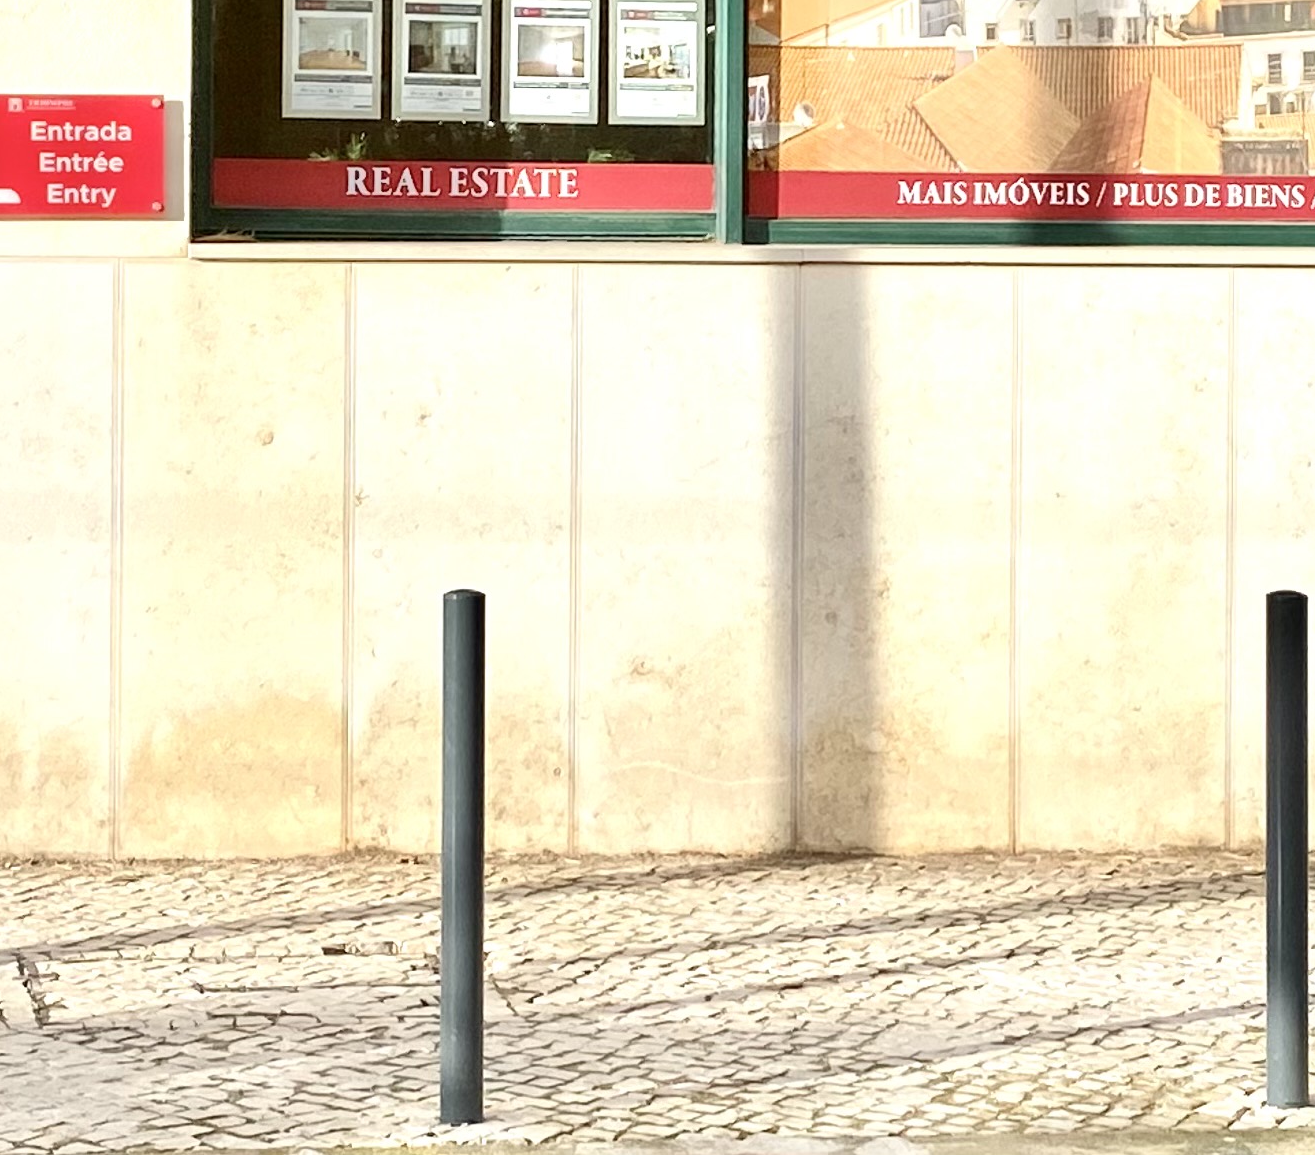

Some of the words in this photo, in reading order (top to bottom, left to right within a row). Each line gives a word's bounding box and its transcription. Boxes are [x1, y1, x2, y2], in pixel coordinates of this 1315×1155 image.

[30, 120, 132, 142] Entrada
[39, 151, 125, 173] Entrée
[46, 183, 117, 208] Entry
[345, 167, 441, 196] REAL
[449, 167, 579, 199] ESTATE
[897, 181, 968, 206] MAIS
[973, 176, 1090, 207] IMÓVEIS
[1095, 182, 1107, 208] /
[1113, 182, 1179, 208] PLUS
[1184, 183, 1220, 208] DE
[1227, 183, 1306, 209] BIENS
